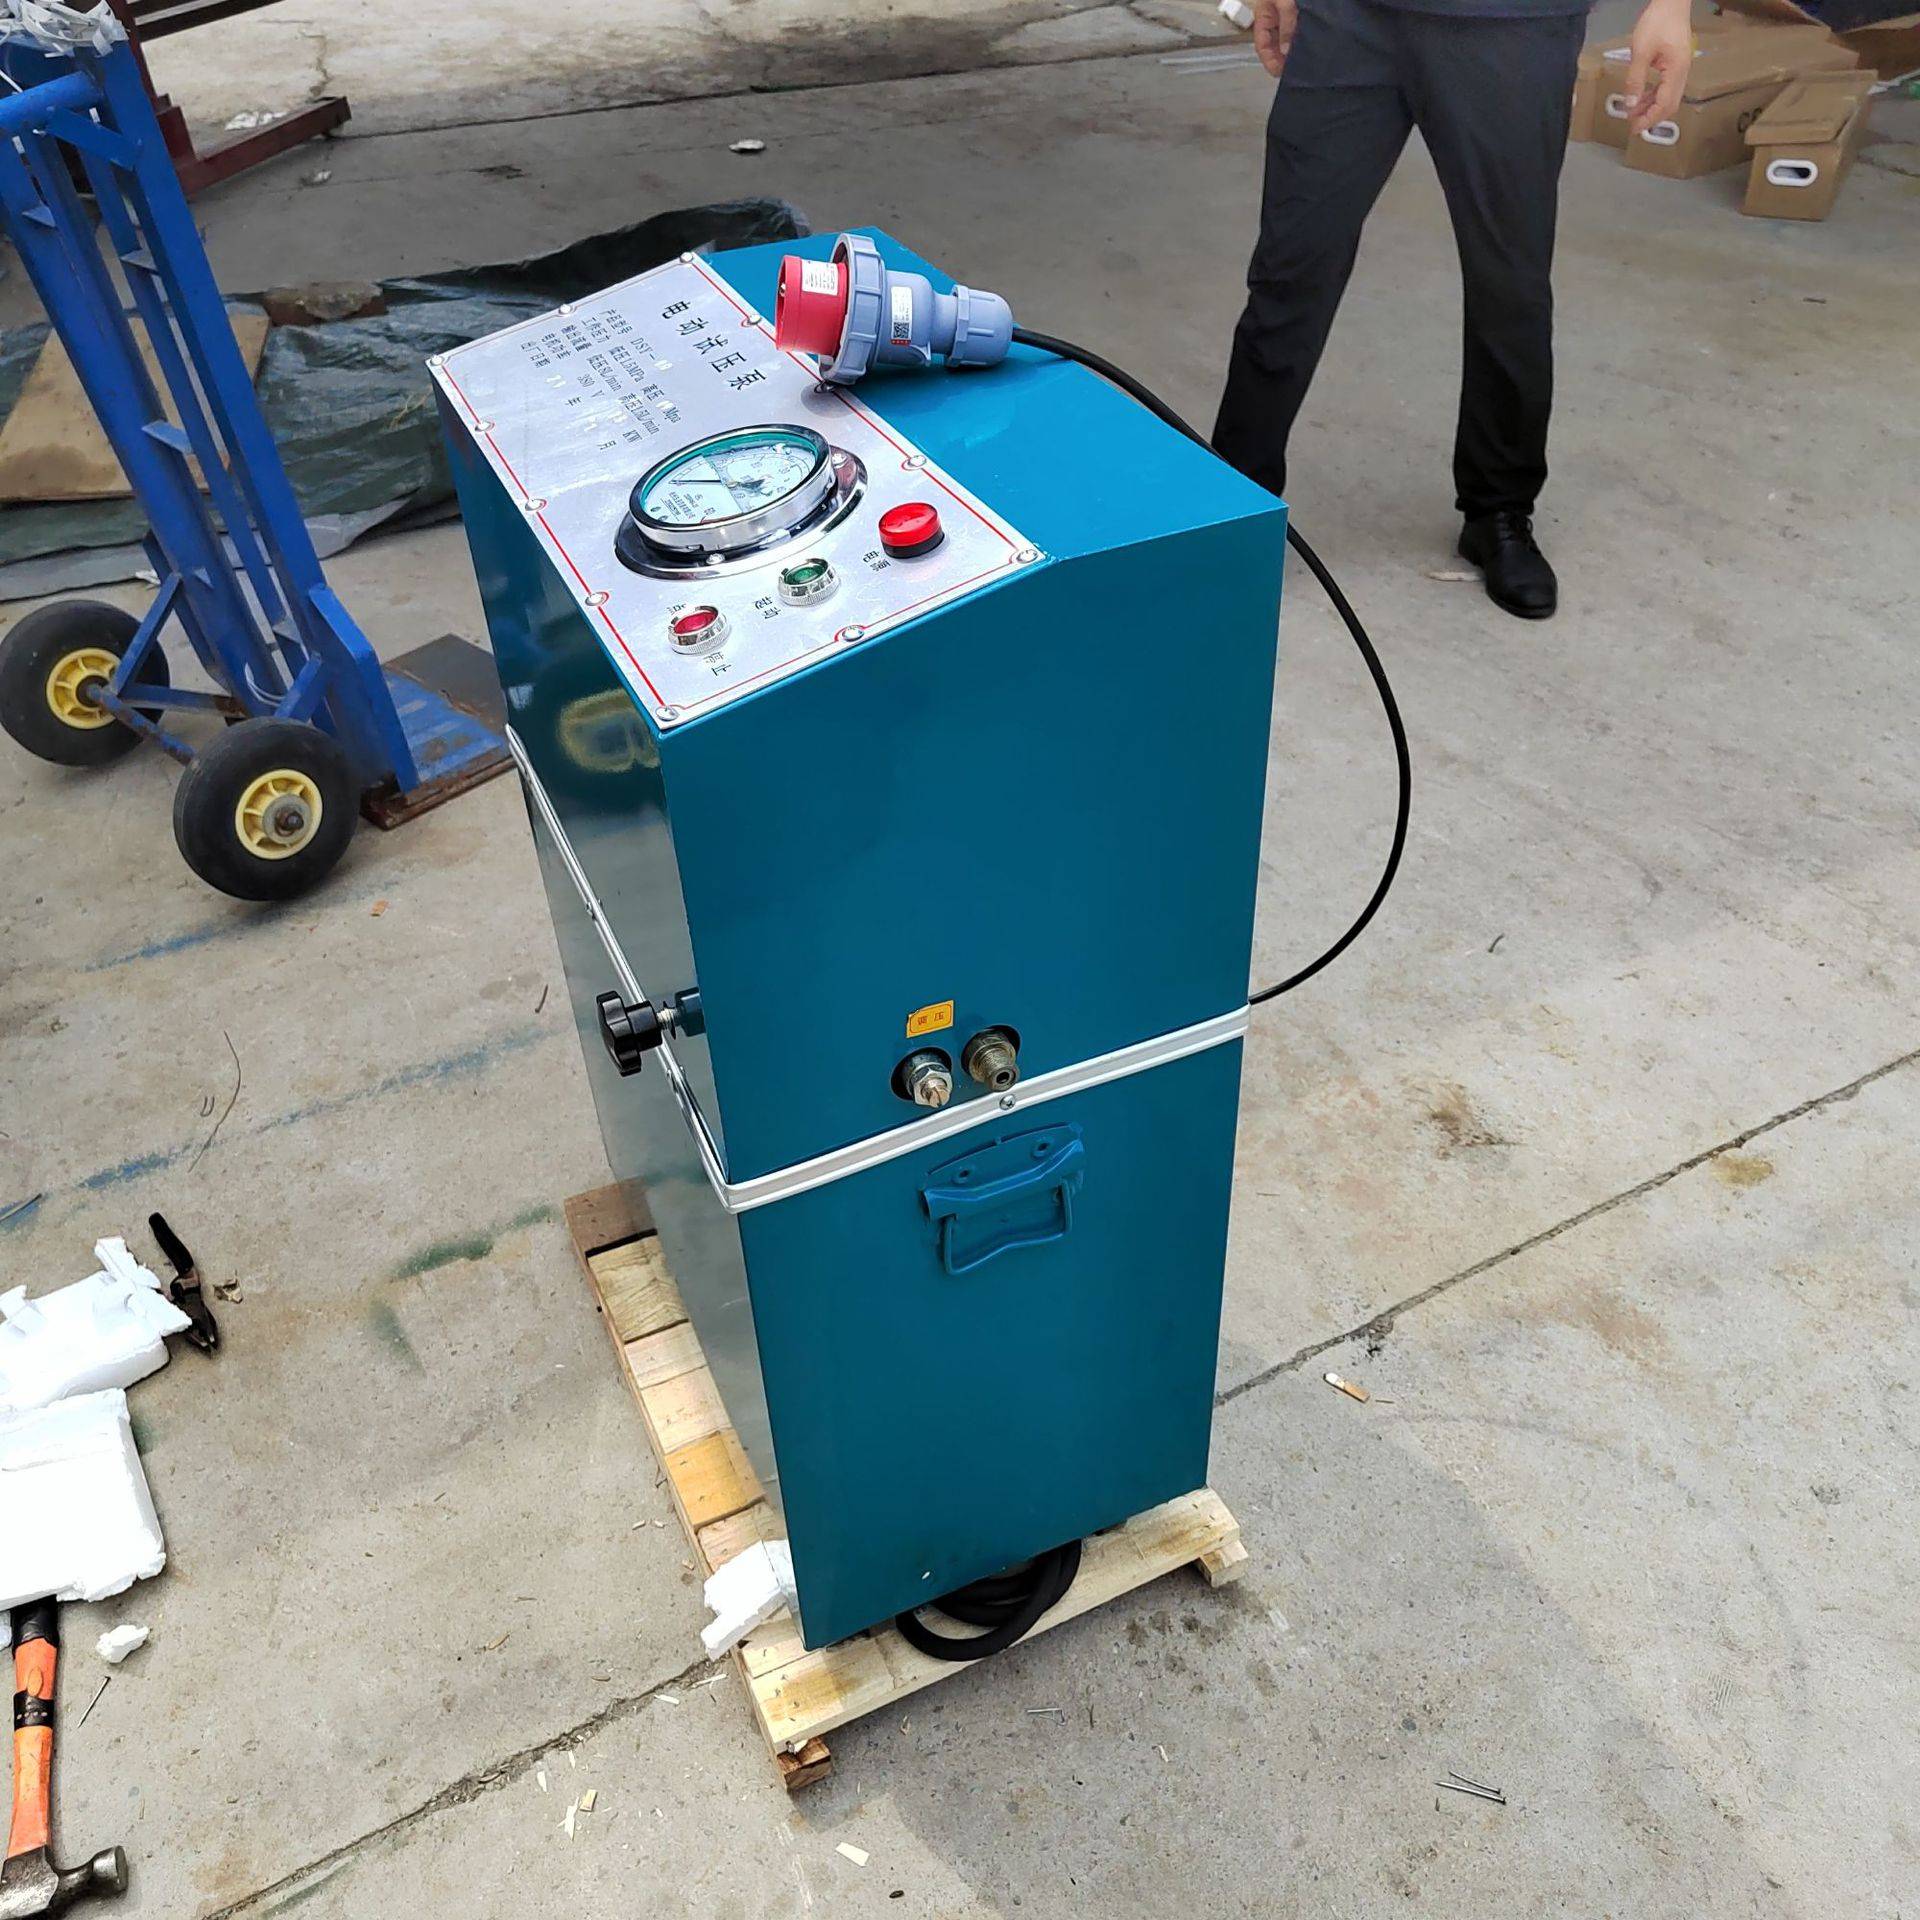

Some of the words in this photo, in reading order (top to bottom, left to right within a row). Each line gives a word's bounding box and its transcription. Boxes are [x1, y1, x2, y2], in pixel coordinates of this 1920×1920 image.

[581, 316, 611, 343] 工作压力
[600, 309, 633, 335] 产品型号
[541, 332, 571, 360] 电机功率
[561, 324, 592, 351] 输出流量
[661, 300, 766, 391] 电动试压泵
[520, 341, 551, 368] 出厂日期
[564, 396, 583, 407] 年
